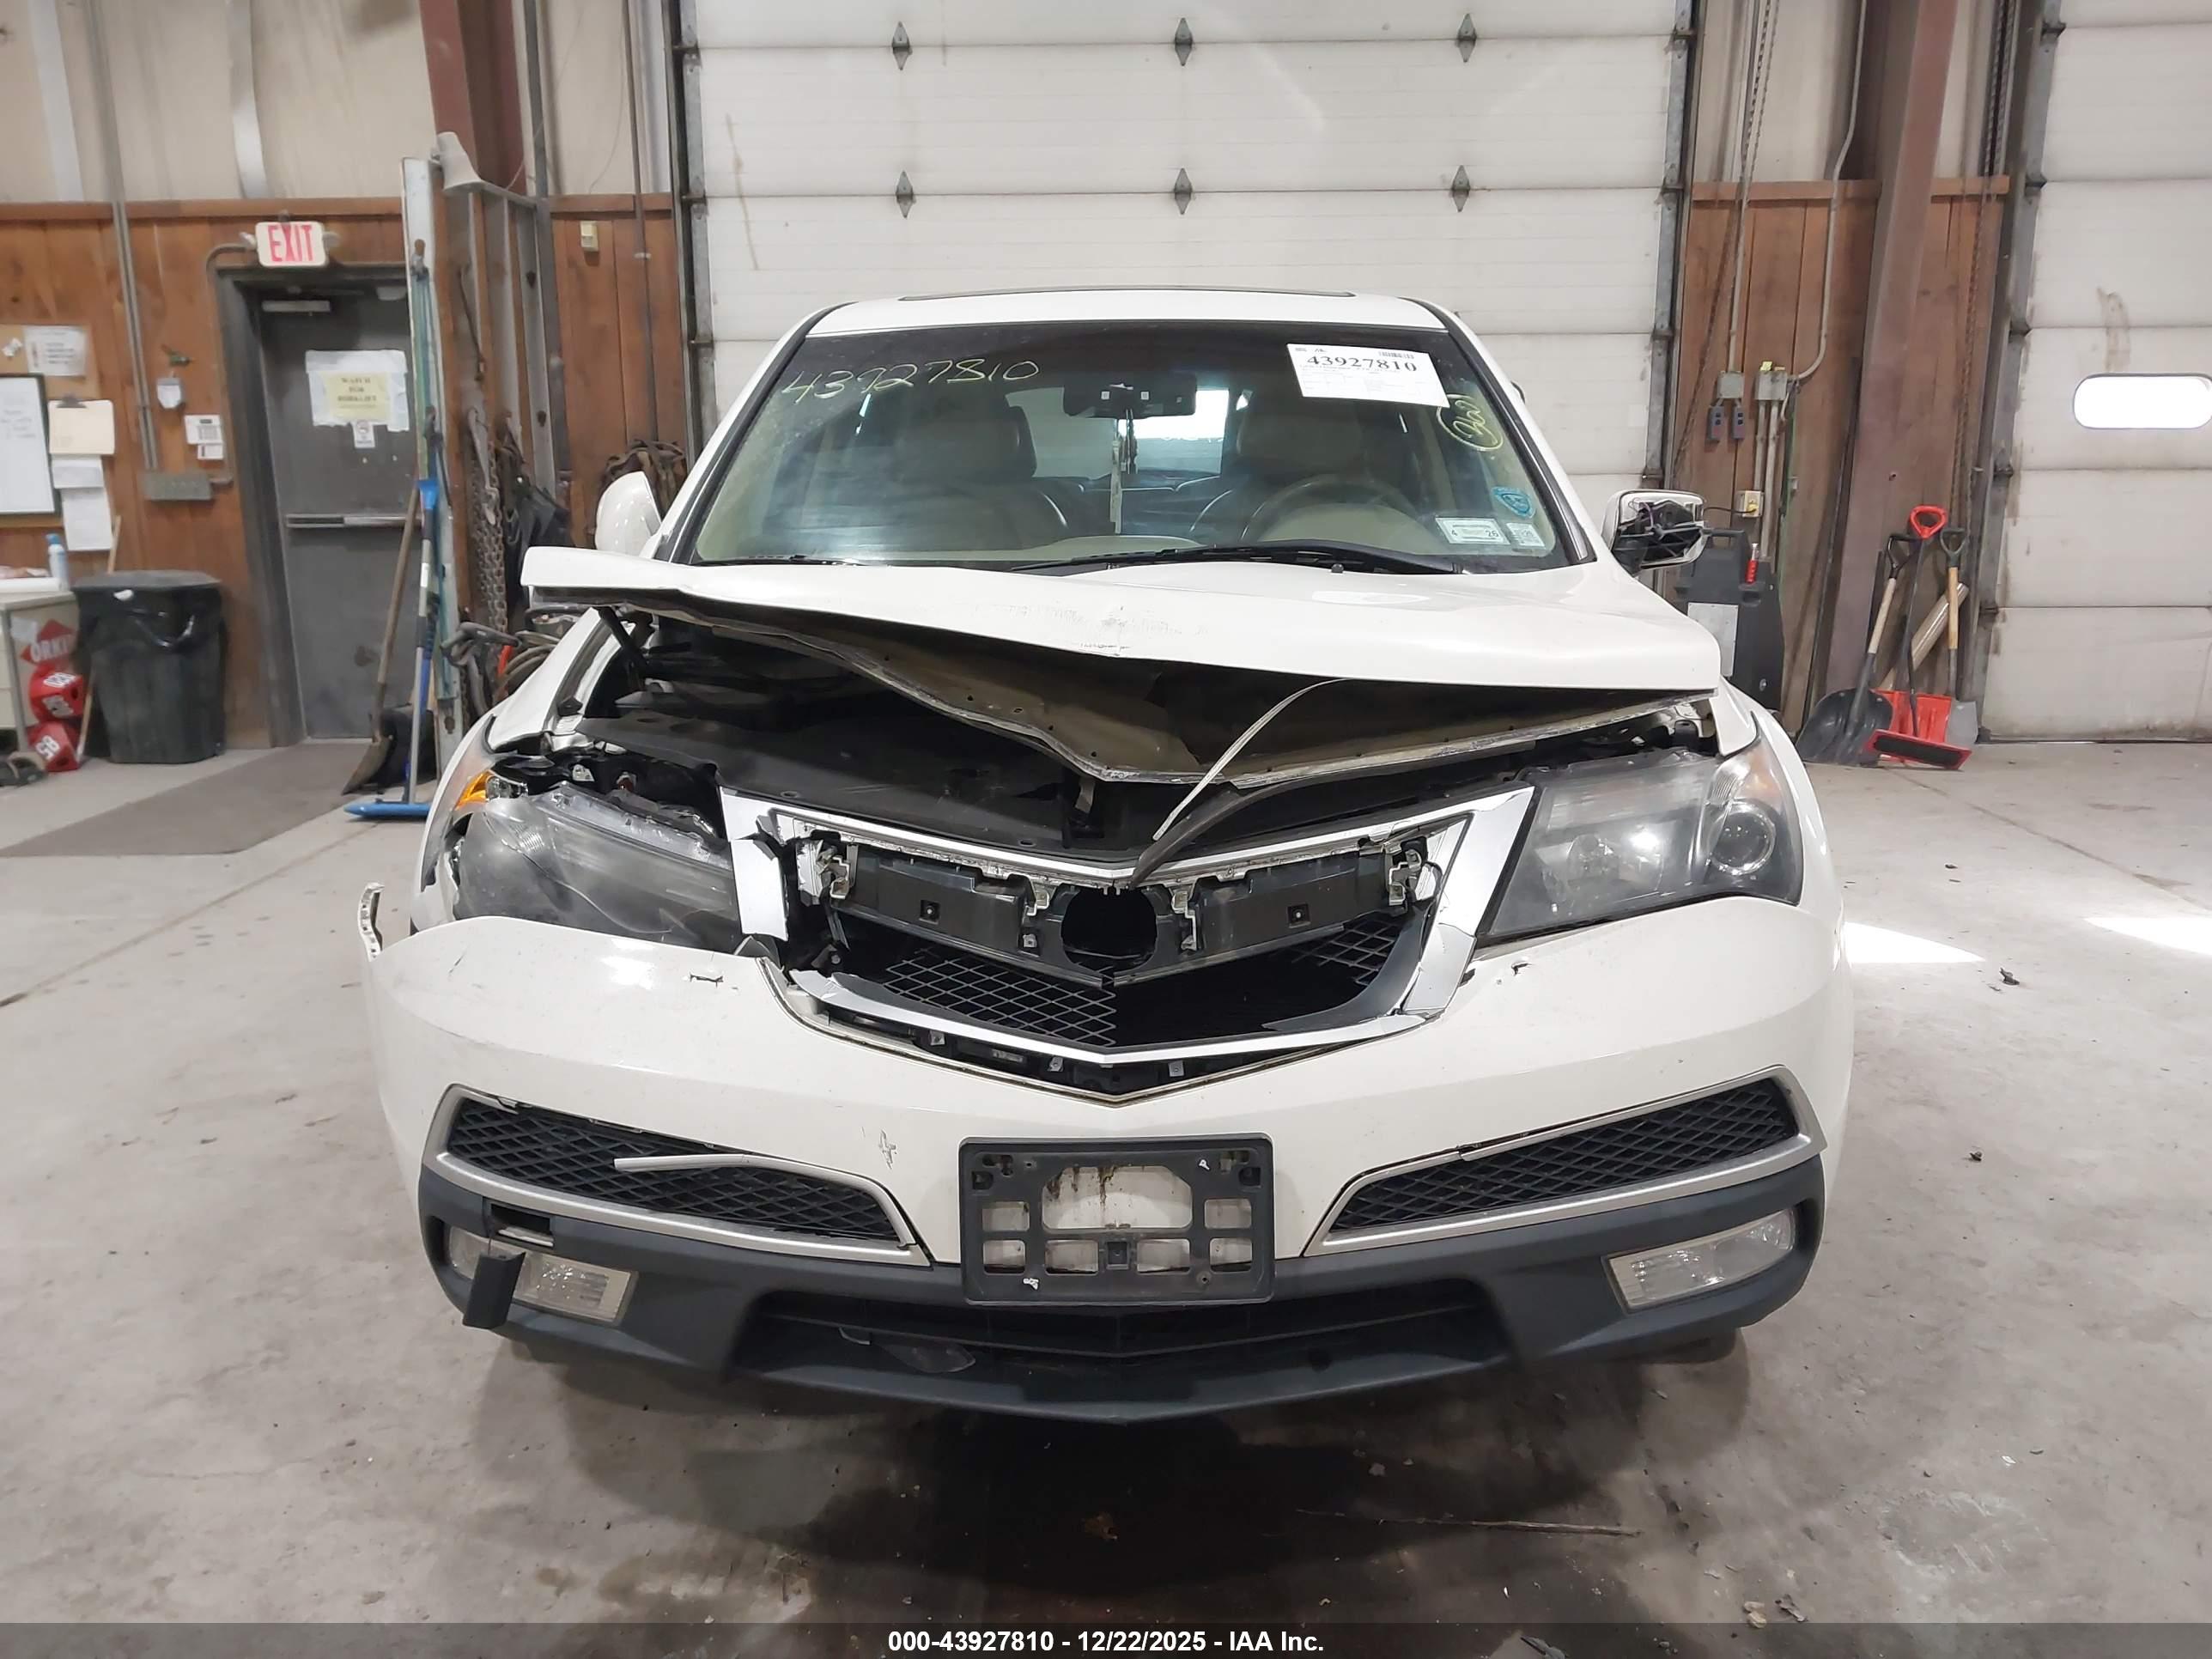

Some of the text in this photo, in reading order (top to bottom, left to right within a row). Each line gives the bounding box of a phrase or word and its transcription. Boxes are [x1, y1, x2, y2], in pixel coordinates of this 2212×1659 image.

[268, 225, 313, 262] EXIT
[781, 358, 1040, 404] 43927810
[1307, 355, 1418, 373] 43927810
